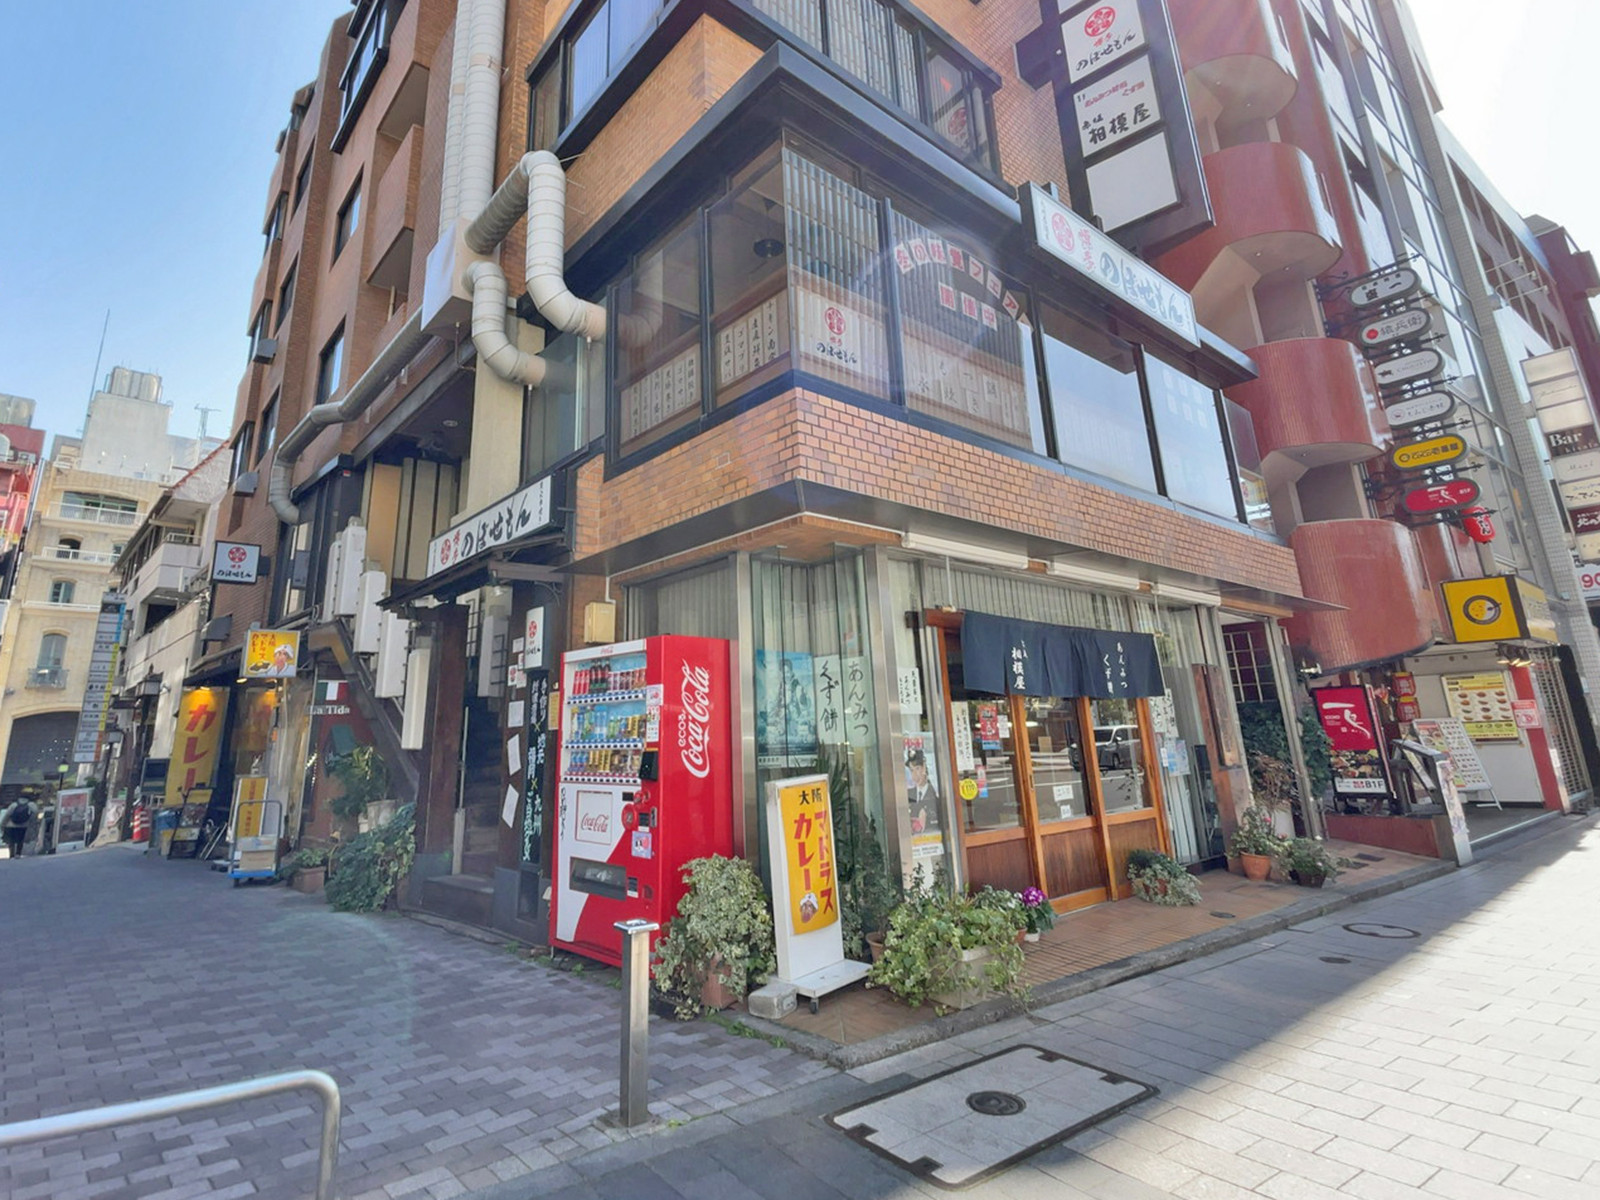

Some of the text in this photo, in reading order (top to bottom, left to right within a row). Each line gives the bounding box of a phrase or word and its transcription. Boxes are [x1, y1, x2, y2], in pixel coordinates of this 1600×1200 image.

[1089, 103, 1151, 146] 相模屋
[1549, 431, 1584, 449] Bar
[819, 660, 840, 734] くず餅
[847, 660, 870, 737] あんみつ
[1011, 646, 1026, 690] 相模屋
[1116, 642, 1129, 689] あんみつ
[184, 703, 217, 793] カレー
[681, 658, 710, 778] Coca-Cola
[799, 787, 823, 805] 大阪
[794, 812, 814, 891] カレー
[814, 809, 834, 915] マドラス
